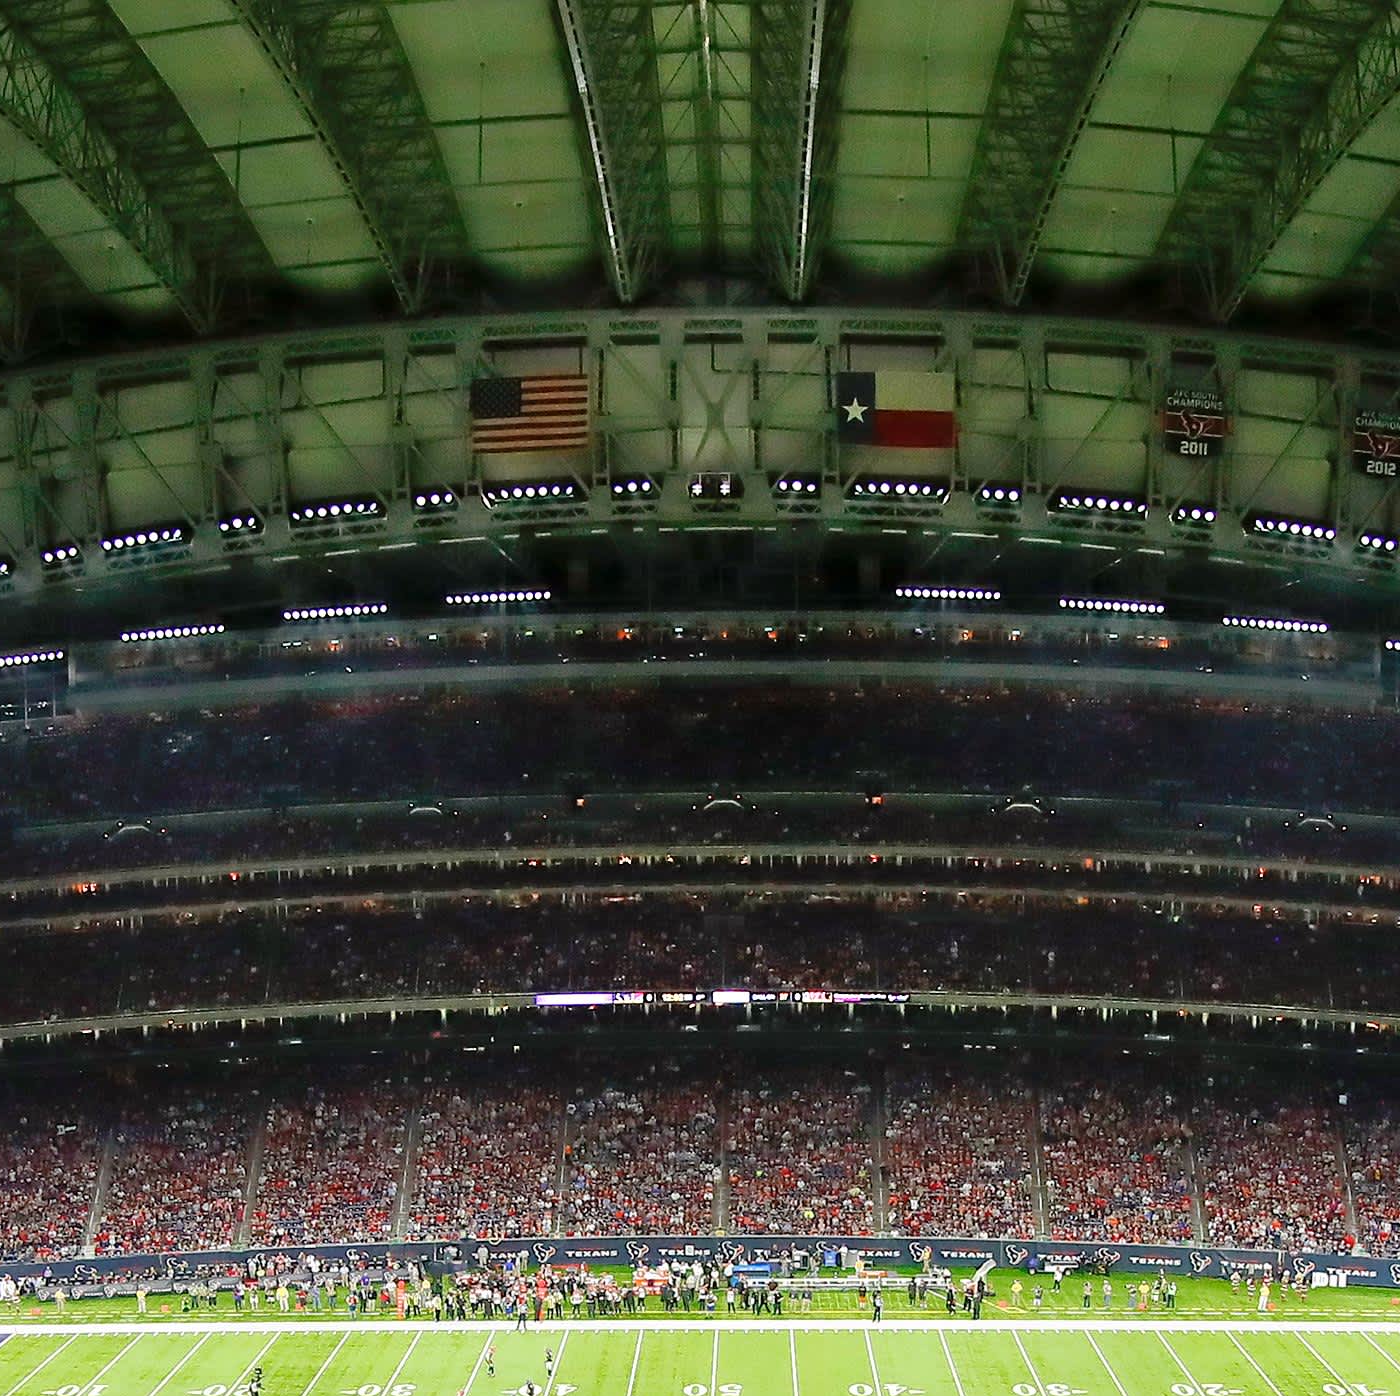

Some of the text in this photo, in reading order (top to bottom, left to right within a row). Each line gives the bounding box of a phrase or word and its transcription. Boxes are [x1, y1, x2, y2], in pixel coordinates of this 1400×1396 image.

[1167, 397, 1223, 410] CHAMPIONS
[1180, 440, 1208, 456] 2011
[1367, 460, 1397, 476] 2012
[564, 1249, 619, 1259] TEXANS
[657, 1248, 712, 1258] TEXNS
[857, 1249, 901, 1258] EXANS
[940, 1250, 994, 1260] TEXANS
[1128, 1256, 1182, 1267] TEXANS
[1326, 1267, 1378, 1279] TEXANS
